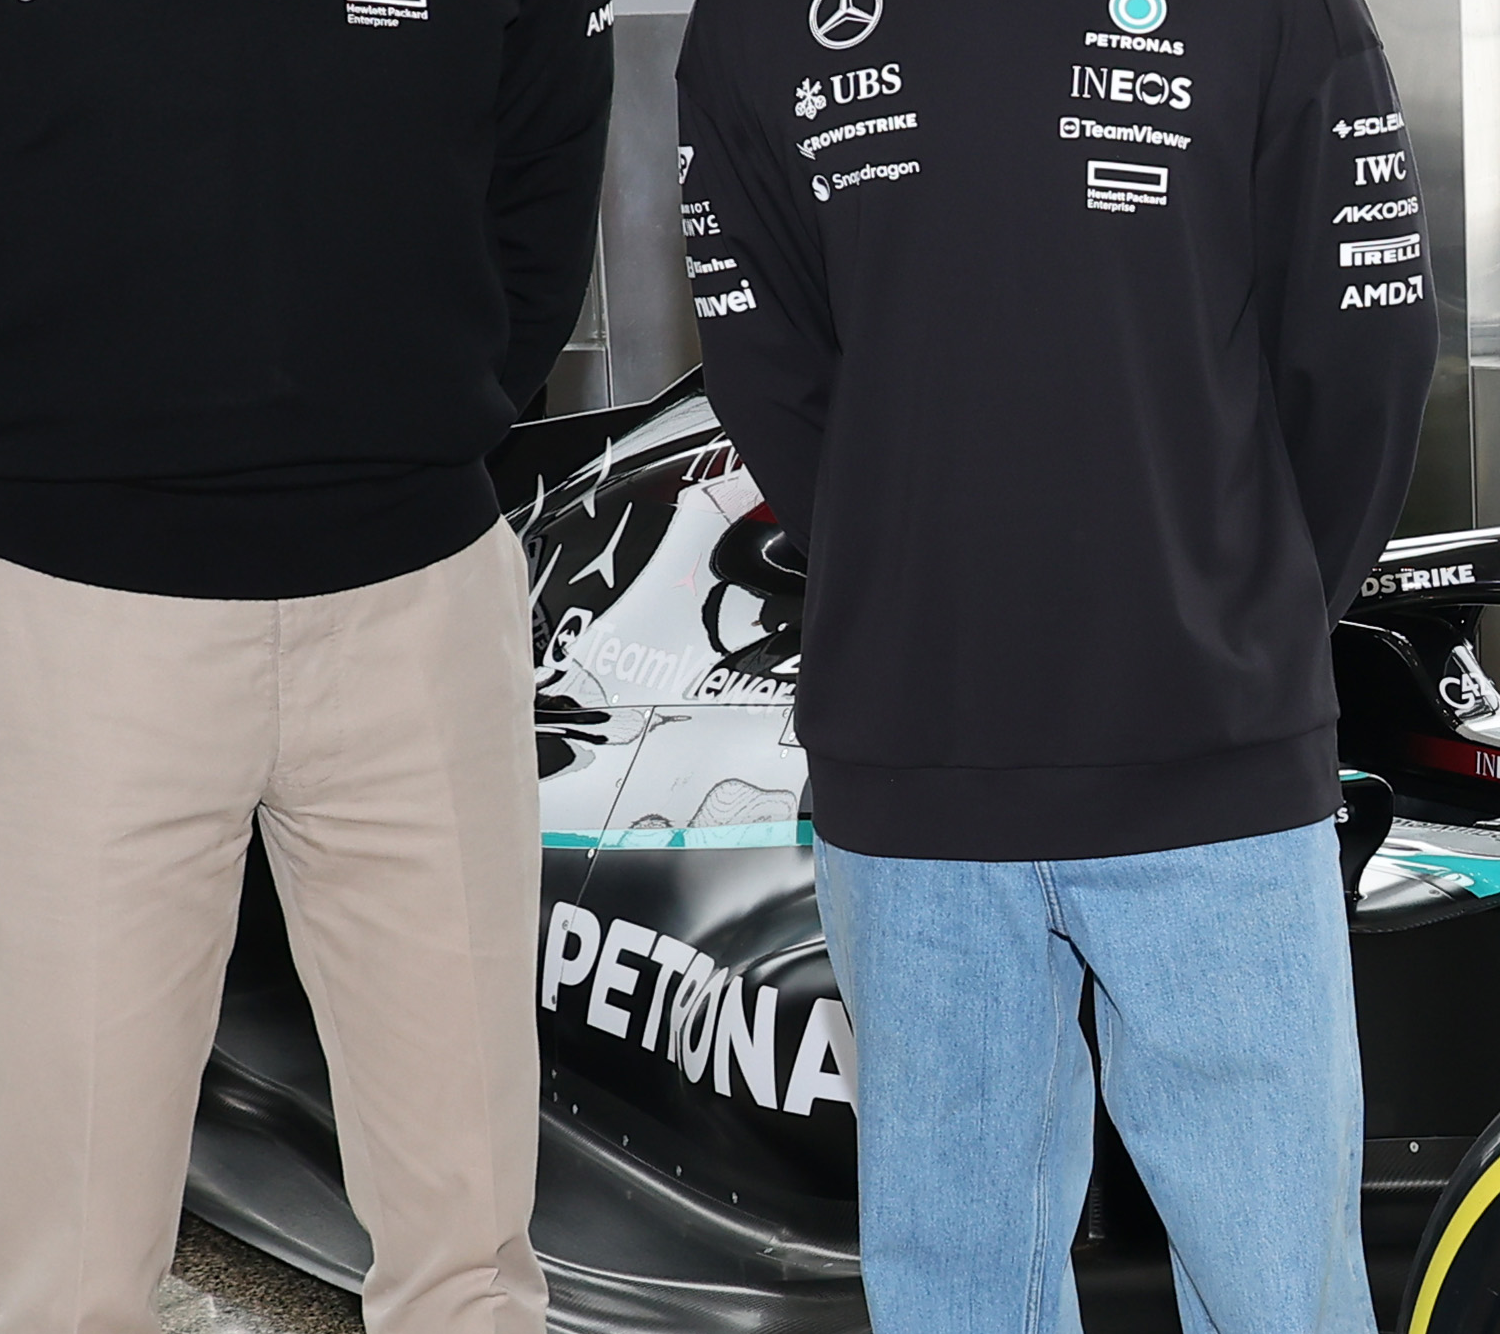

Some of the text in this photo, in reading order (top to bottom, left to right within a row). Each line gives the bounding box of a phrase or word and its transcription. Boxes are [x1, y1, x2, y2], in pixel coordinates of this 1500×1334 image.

[347, 14, 400, 28] Enterprise
[387, 7, 429, 21] Packard
[1085, 32, 1185, 56] PETRONAS
[829, 63, 902, 105] UBS
[1070, 64, 1193, 110] INEOS
[803, 113, 918, 154] CROWDSTRIKE
[1081, 119, 1192, 151] TeamViewer
[831, 159, 920, 193] Snapdragon
[1355, 151, 1407, 186] IWC
[1086, 188, 1167, 206] Hewlett Packard
[1086, 198, 1136, 214] Enterprise
[1339, 233, 1421, 267] PIRELLI
[694, 278, 757, 318] nuvei
[1340, 281, 1408, 310] AMD
[541, 901, 858, 1120] PETRONA
